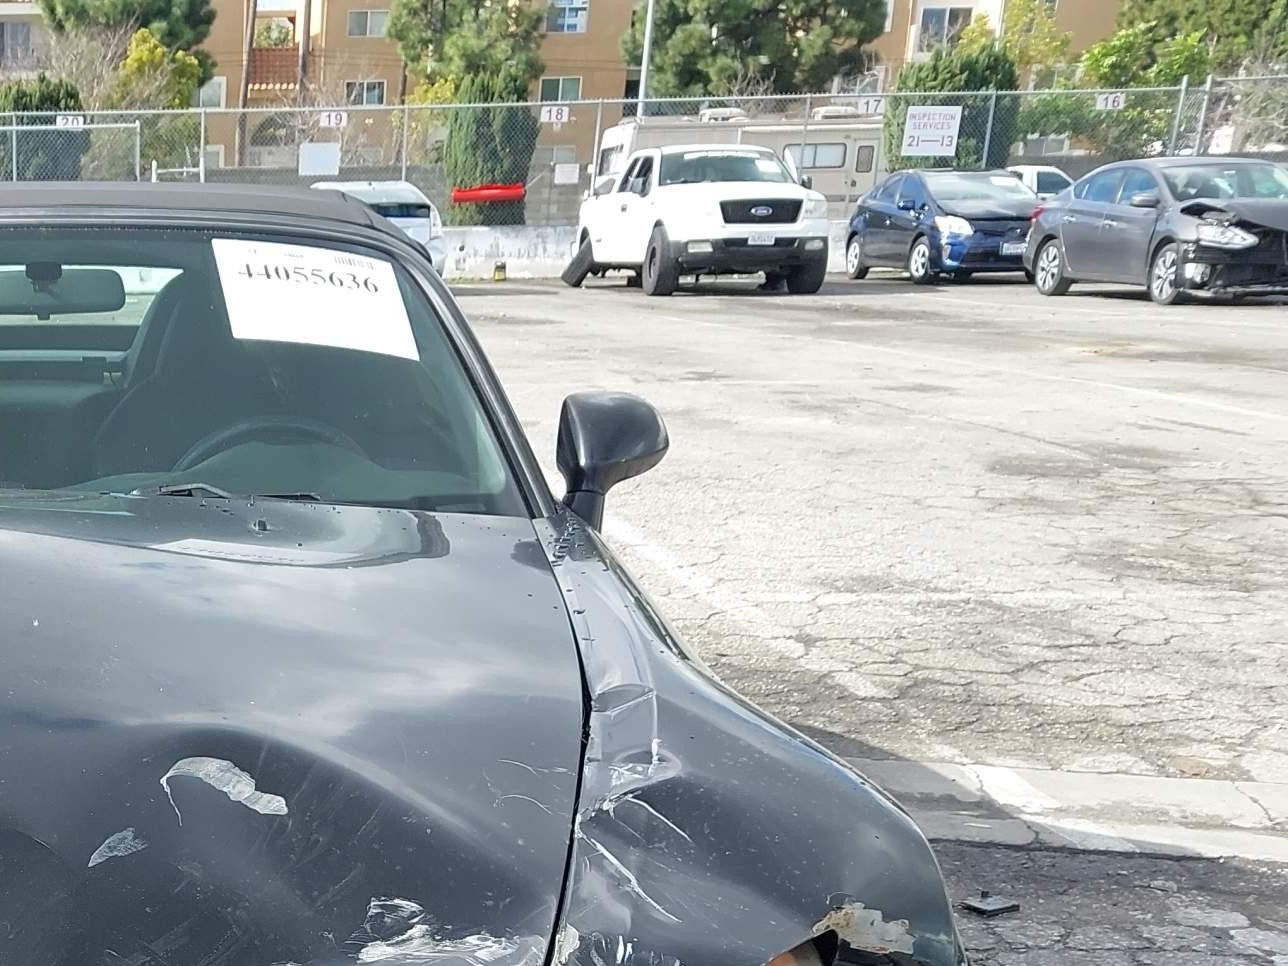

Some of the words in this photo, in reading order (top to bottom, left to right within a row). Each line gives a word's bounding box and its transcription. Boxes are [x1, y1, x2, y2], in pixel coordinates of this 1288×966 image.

[864, 99, 881, 113] 17
[1103, 95, 1120, 108] 16
[325, 112, 343, 126] 19
[546, 107, 563, 121] 18
[909, 113, 956, 121] INSPECTION
[61, 116, 80, 127] 20
[912, 121, 951, 130] SERVICES
[238, 263, 379, 293] 44055636
